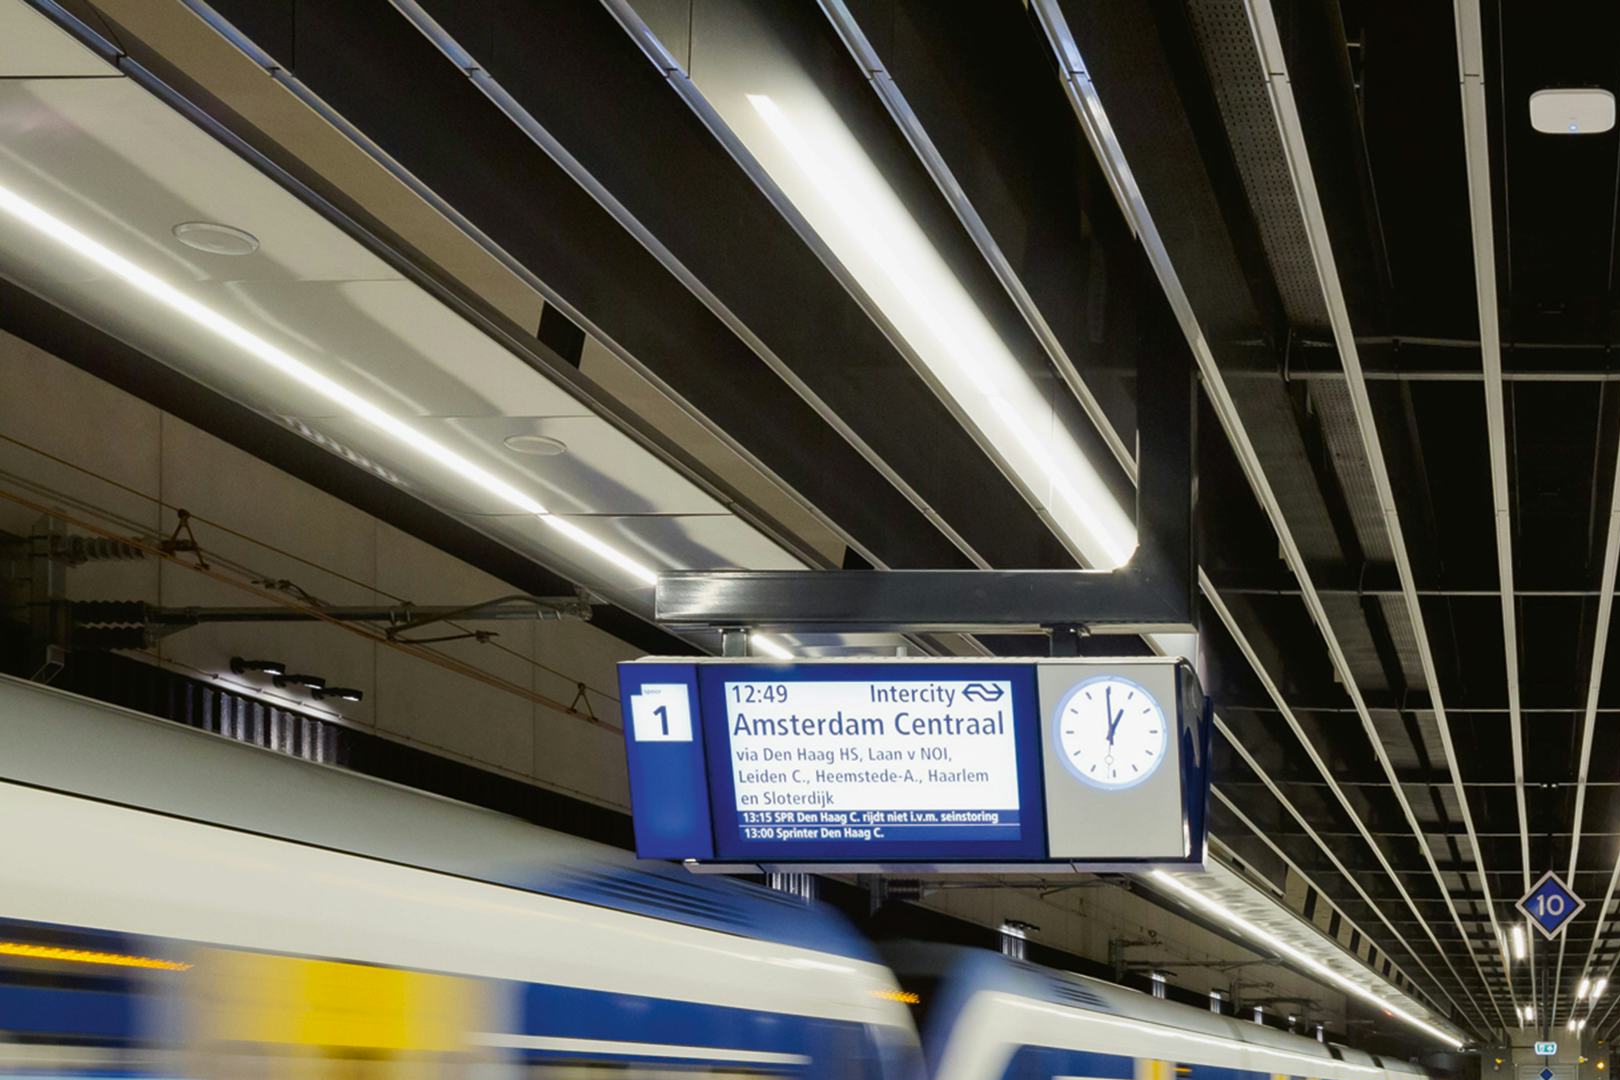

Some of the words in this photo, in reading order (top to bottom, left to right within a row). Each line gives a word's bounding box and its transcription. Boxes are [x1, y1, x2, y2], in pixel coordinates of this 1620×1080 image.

[732, 685, 788, 703] 12:49
[870, 683, 956, 708] Intercity
[653, 705, 669, 736] 1
[733, 711, 884, 736] Amsterdam
[894, 710, 1004, 735] Centraal
[736, 747, 758, 761] via
[763, 747, 792, 761] Den
[797, 747, 835, 765] Haag
[839, 747, 863, 763] HS,
[868, 747, 902, 761] Laan
[907, 750, 916, 761] v
[920, 747, 952, 763] NOI,
[739, 769, 787, 783] Leiden
[792, 769, 810, 784] C.,
[816, 769, 923, 784] Heemstede-A.,
[928, 769, 989, 782] Haarlem
[741, 794, 759, 805] en
[763, 790, 835, 808] Sloterdijk
[743, 812, 772, 823] 13:15
[774, 812, 795, 823] SPR
[797, 812, 818, 823] Den
[820, 812, 847, 825] Haag
[849, 812, 861, 823] C.
[863, 811, 884, 825] rijdt
[887, 811, 908, 823] niet
[910, 811, 939, 823] i.v.m.
[941, 811, 999, 824] seinstoring
[744, 828, 774, 839] 13:00
[776, 827, 818, 841] Sprinter
[821, 828, 841, 839] Den
[844, 828, 871, 840] Haag
[873, 827, 885, 838] C.
[1536, 894, 1565, 916] 10
